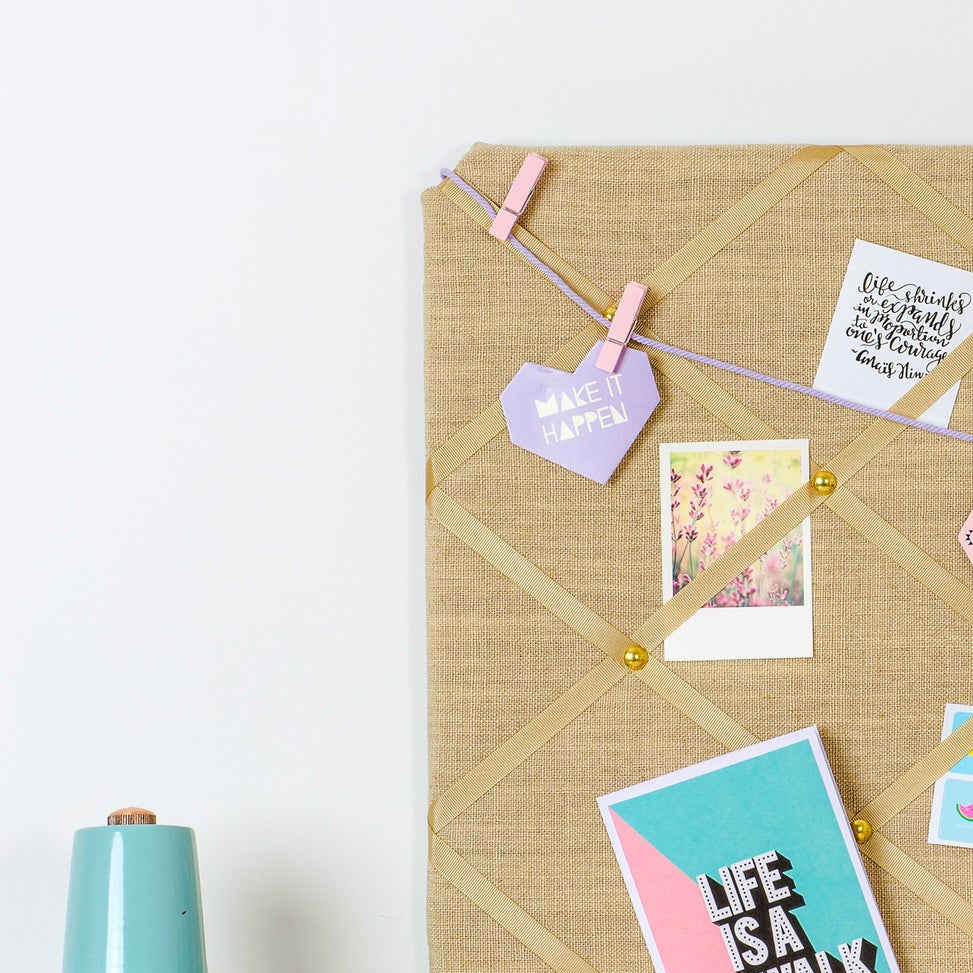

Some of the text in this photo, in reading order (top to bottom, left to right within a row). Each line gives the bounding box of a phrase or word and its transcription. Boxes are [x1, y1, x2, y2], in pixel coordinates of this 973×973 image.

[858, 272, 972, 315] life shrinks
[851, 314, 868, 329] to
[853, 303, 950, 348] in proportion
[863, 295, 962, 340] or expands
[534, 374, 623, 419] MAKE IT
[541, 402, 628, 446] HAPPEN
[696, 850, 800, 923] LIFE
[719, 905, 807, 973] IS A
